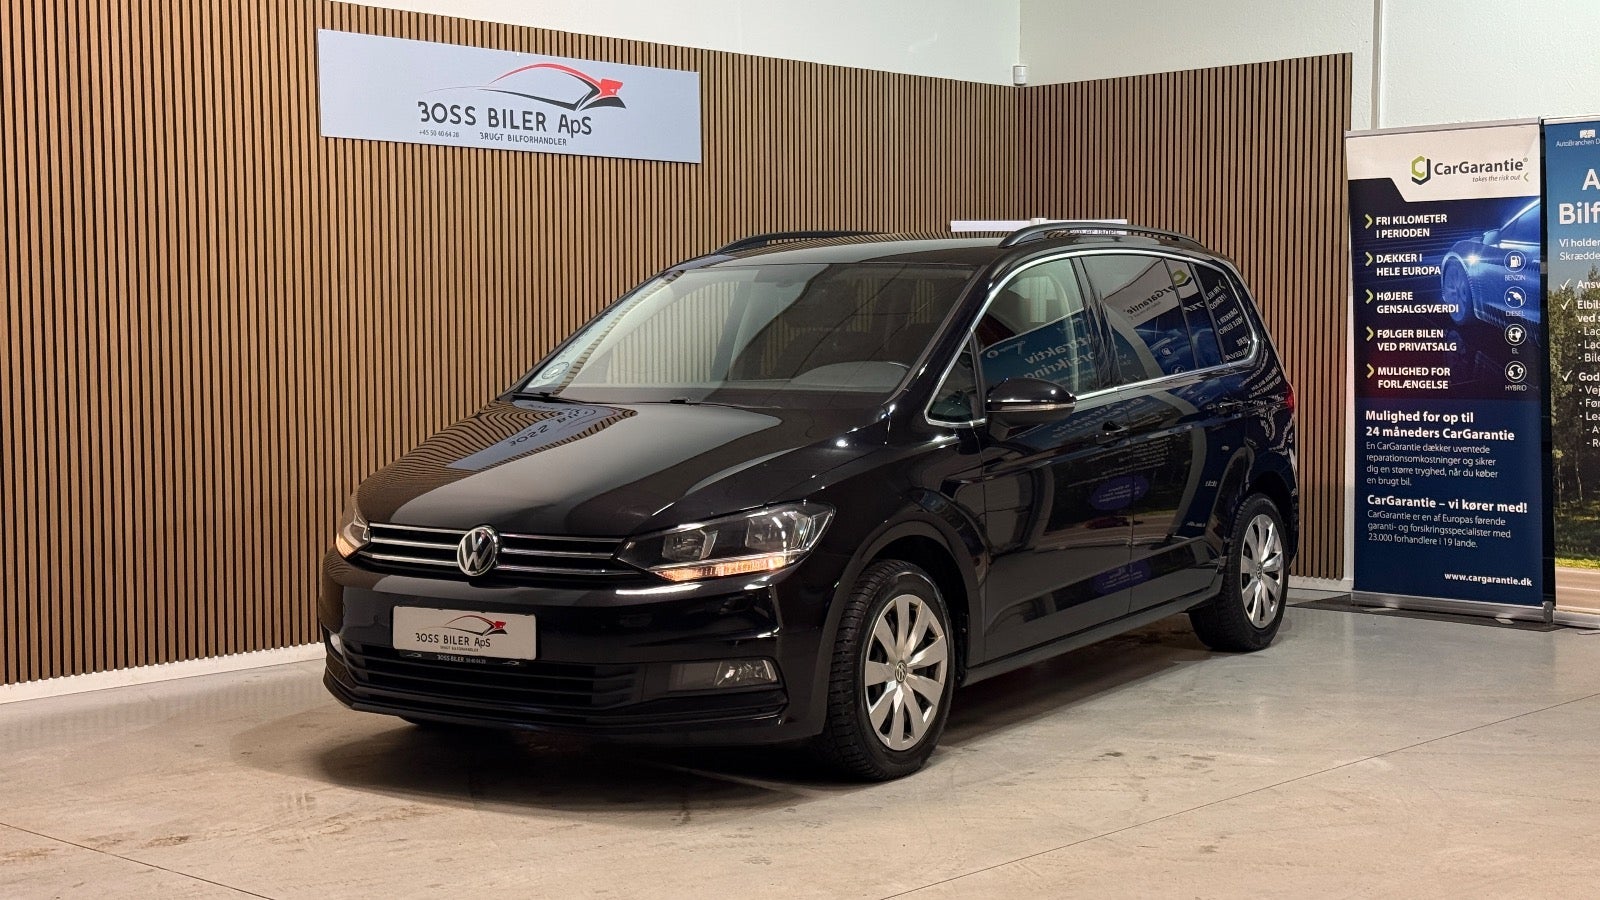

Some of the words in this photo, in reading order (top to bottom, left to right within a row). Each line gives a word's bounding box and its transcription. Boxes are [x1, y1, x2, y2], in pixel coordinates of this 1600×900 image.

[488, 108, 547, 132] BILER
[558, 114, 592, 138] ApS
[508, 134, 567, 146] BILFORHANDLER
[1376, 217, 1390, 226] FRI
[1393, 214, 1448, 225] KILOMETER
[1376, 230, 1379, 238] I
[1382, 228, 1430, 238] PERIODEN
[1559, 239, 1569, 247] Vi
[1376, 254, 1417, 263] DÆKKER
[1420, 254, 1422, 262] I
[1376, 267, 1400, 276] HELE
[1403, 266, 1441, 275] EUROPA
[1376, 292, 1413, 301] HØJERE
[1377, 304, 1459, 314] GENSALGSVÆRDI
[1578, 300, 1600, 310] Elbil
[1576, 313, 1595, 323] ved
[1377, 329, 1414, 338] FØLGER
[1416, 329, 1444, 338] BILEN
[1377, 342, 1397, 351] VED
[1399, 342, 1457, 351] PRIVATSALG
[1377, 367, 1429, 376] MULIGHED
[1431, 367, 1450, 376] FOR
[1378, 380, 1448, 389] FORLÆNGELSE
[1366, 410, 1420, 423] Mulighed
[1423, 411, 1440, 422] for
[1443, 414, 1458, 425] op
[1461, 412, 1474, 422] til
[1366, 427, 1380, 436] 24
[1382, 426, 1440, 438] måneders
[1443, 428, 1515, 440] CarGarantie
[1377, 442, 1421, 451] CarGarantie
[1423, 443, 1451, 452] dækker
[1453, 445, 1490, 454] uventede
[1366, 454, 1461, 466] reparationsomkostninger
[1462, 459, 1473, 467] og
[1475, 457, 1496, 466] sikrer
[1366, 465, 1378, 474] dig
[1449, 468, 1461, 476] når
[1463, 469, 1473, 477] du
[1476, 469, 1499, 478] køber
[1378, 477, 1399, 487] brugt
[1401, 477, 1412, 486] bil.
[1367, 495, 1436, 508] CarGarantie
[1448, 499, 1458, 509] vi
[1462, 499, 1494, 511] kører
[1497, 502, 1527, 513] med!
[1368, 510, 1411, 520] CarGarantie
[1433, 514, 1441, 522] af
[1442, 514, 1473, 525] Europas
[1475, 516, 1506, 526] førende
[1367, 523, 1396, 531] garanti-
[1398, 524, 1408, 533] og
[1410, 523, 1491, 537] forsikringsspecialister
[1493, 530, 1511, 538] med
[1368, 533, 1392, 541] 23.000
[1394, 534, 1437, 545] forhandlere
[1444, 538, 1453, 546] 19
[1455, 538, 1478, 548] lande.
[1444, 574, 1532, 586] www.cargarantie.dk
[444, 636, 469, 646] BILER
[474, 637, 491, 649] ApS
